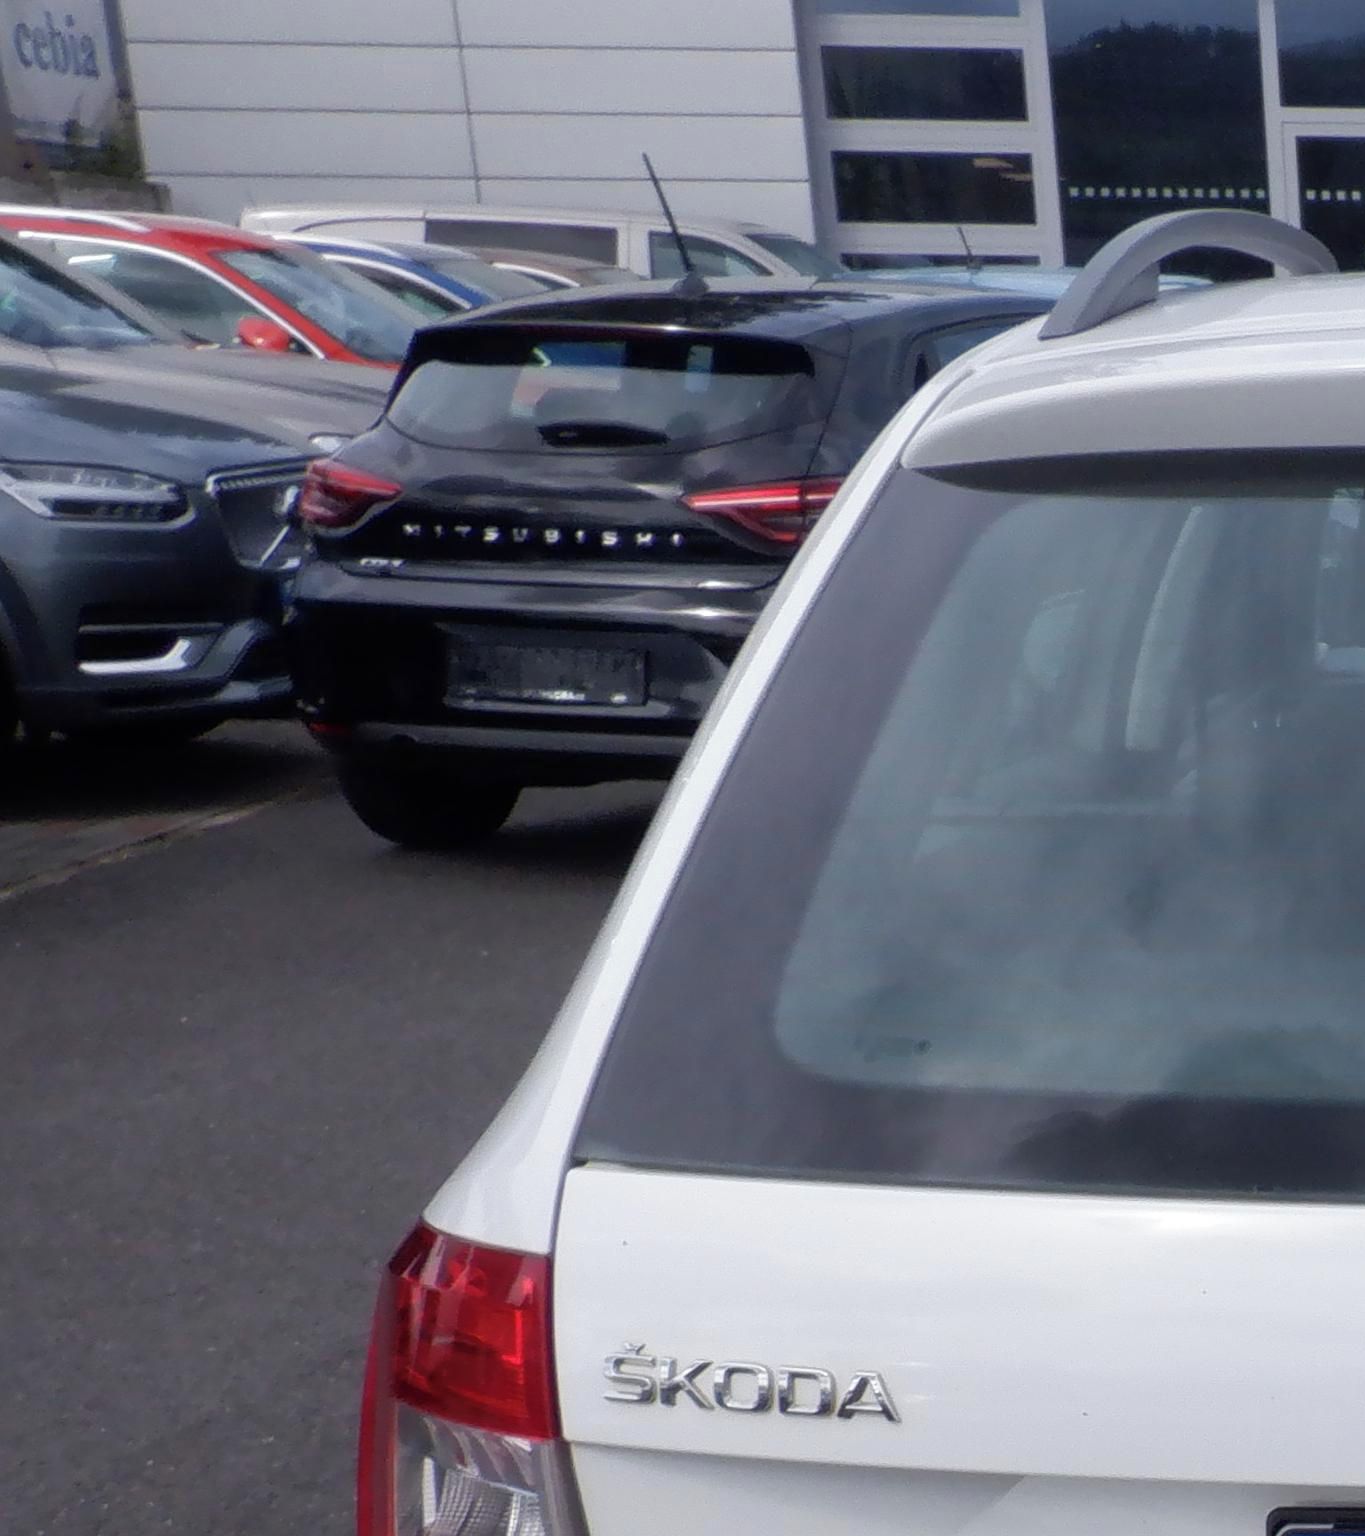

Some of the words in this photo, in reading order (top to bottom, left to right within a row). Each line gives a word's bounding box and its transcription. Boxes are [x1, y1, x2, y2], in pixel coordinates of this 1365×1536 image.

[13, 10, 100, 80] cebia
[402, 523, 688, 548] MITSUBISHI
[603, 1341, 902, 1424] ŠKODA
